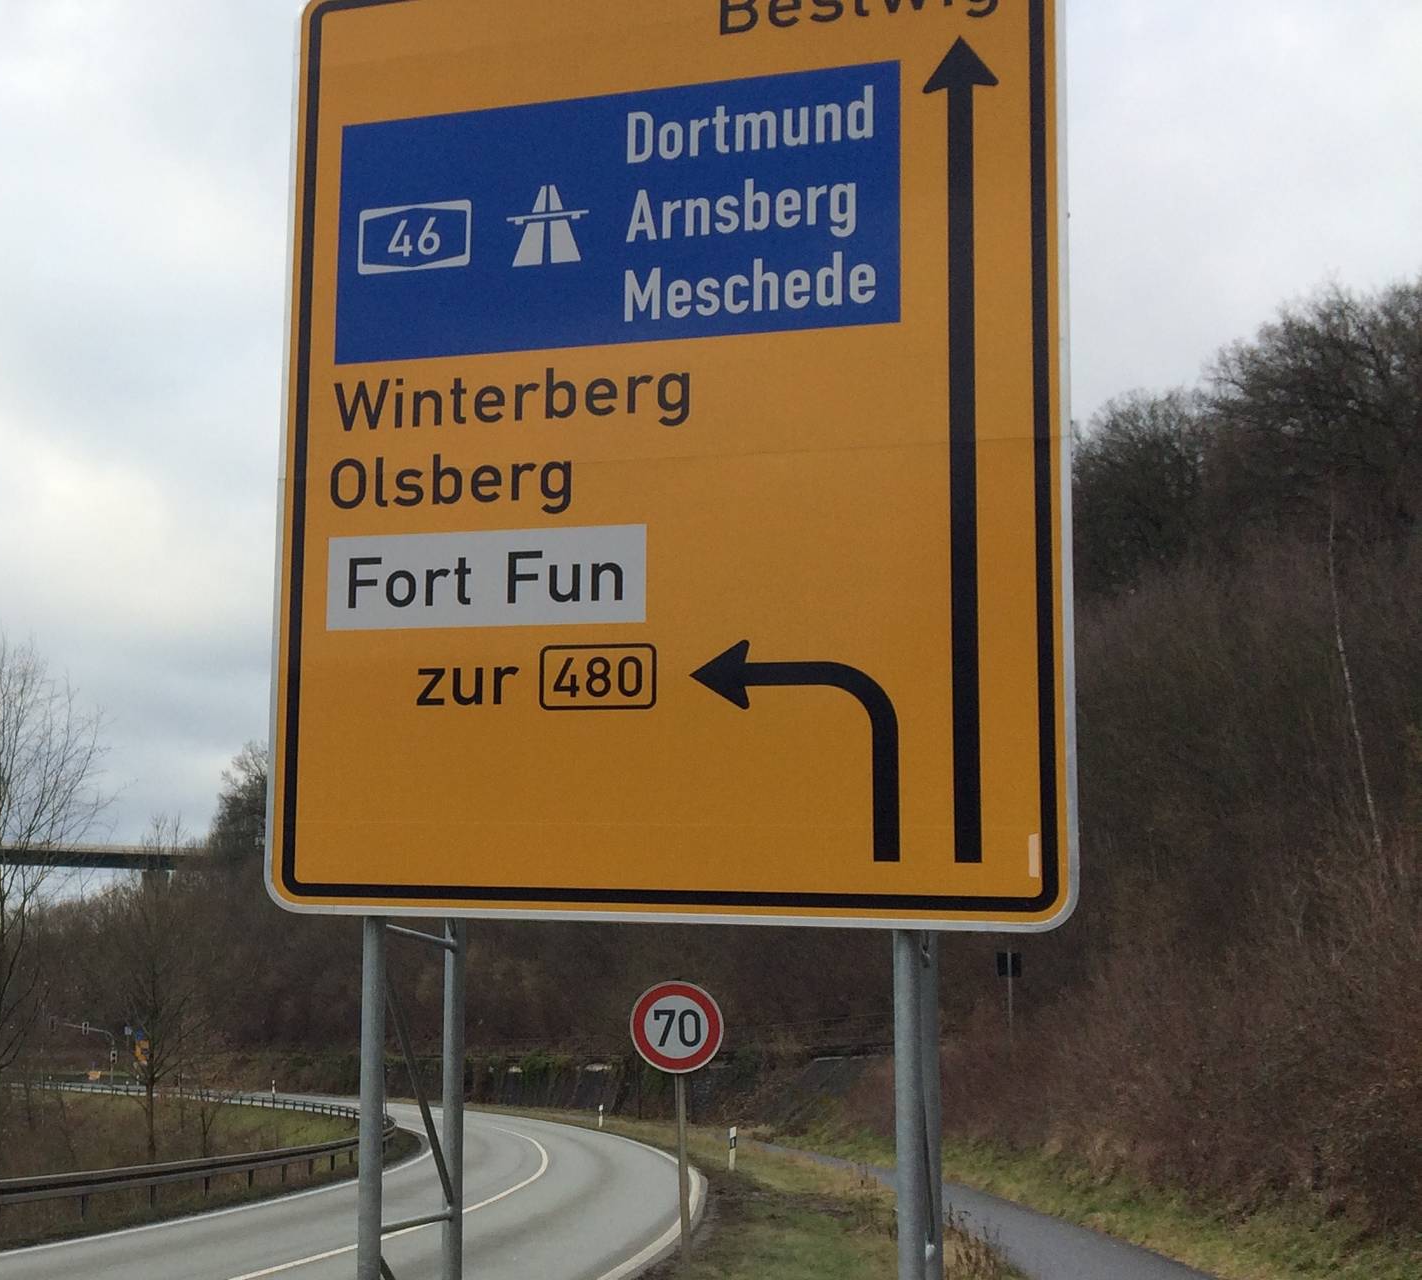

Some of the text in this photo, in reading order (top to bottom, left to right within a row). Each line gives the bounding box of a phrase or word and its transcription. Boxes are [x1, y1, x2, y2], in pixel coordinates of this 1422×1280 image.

[626, 85, 874, 163] Dortmund
[387, 216, 442, 257] 46
[626, 179, 857, 243] Arnsberg
[624, 252, 876, 322] Meschede
[334, 368, 691, 432] Winterberg
[331, 454, 572, 514] Olsberg
[348, 551, 624, 608] Fort Fun
[417, 656, 643, 706] zur 480
[654, 1009, 701, 1047] 70
